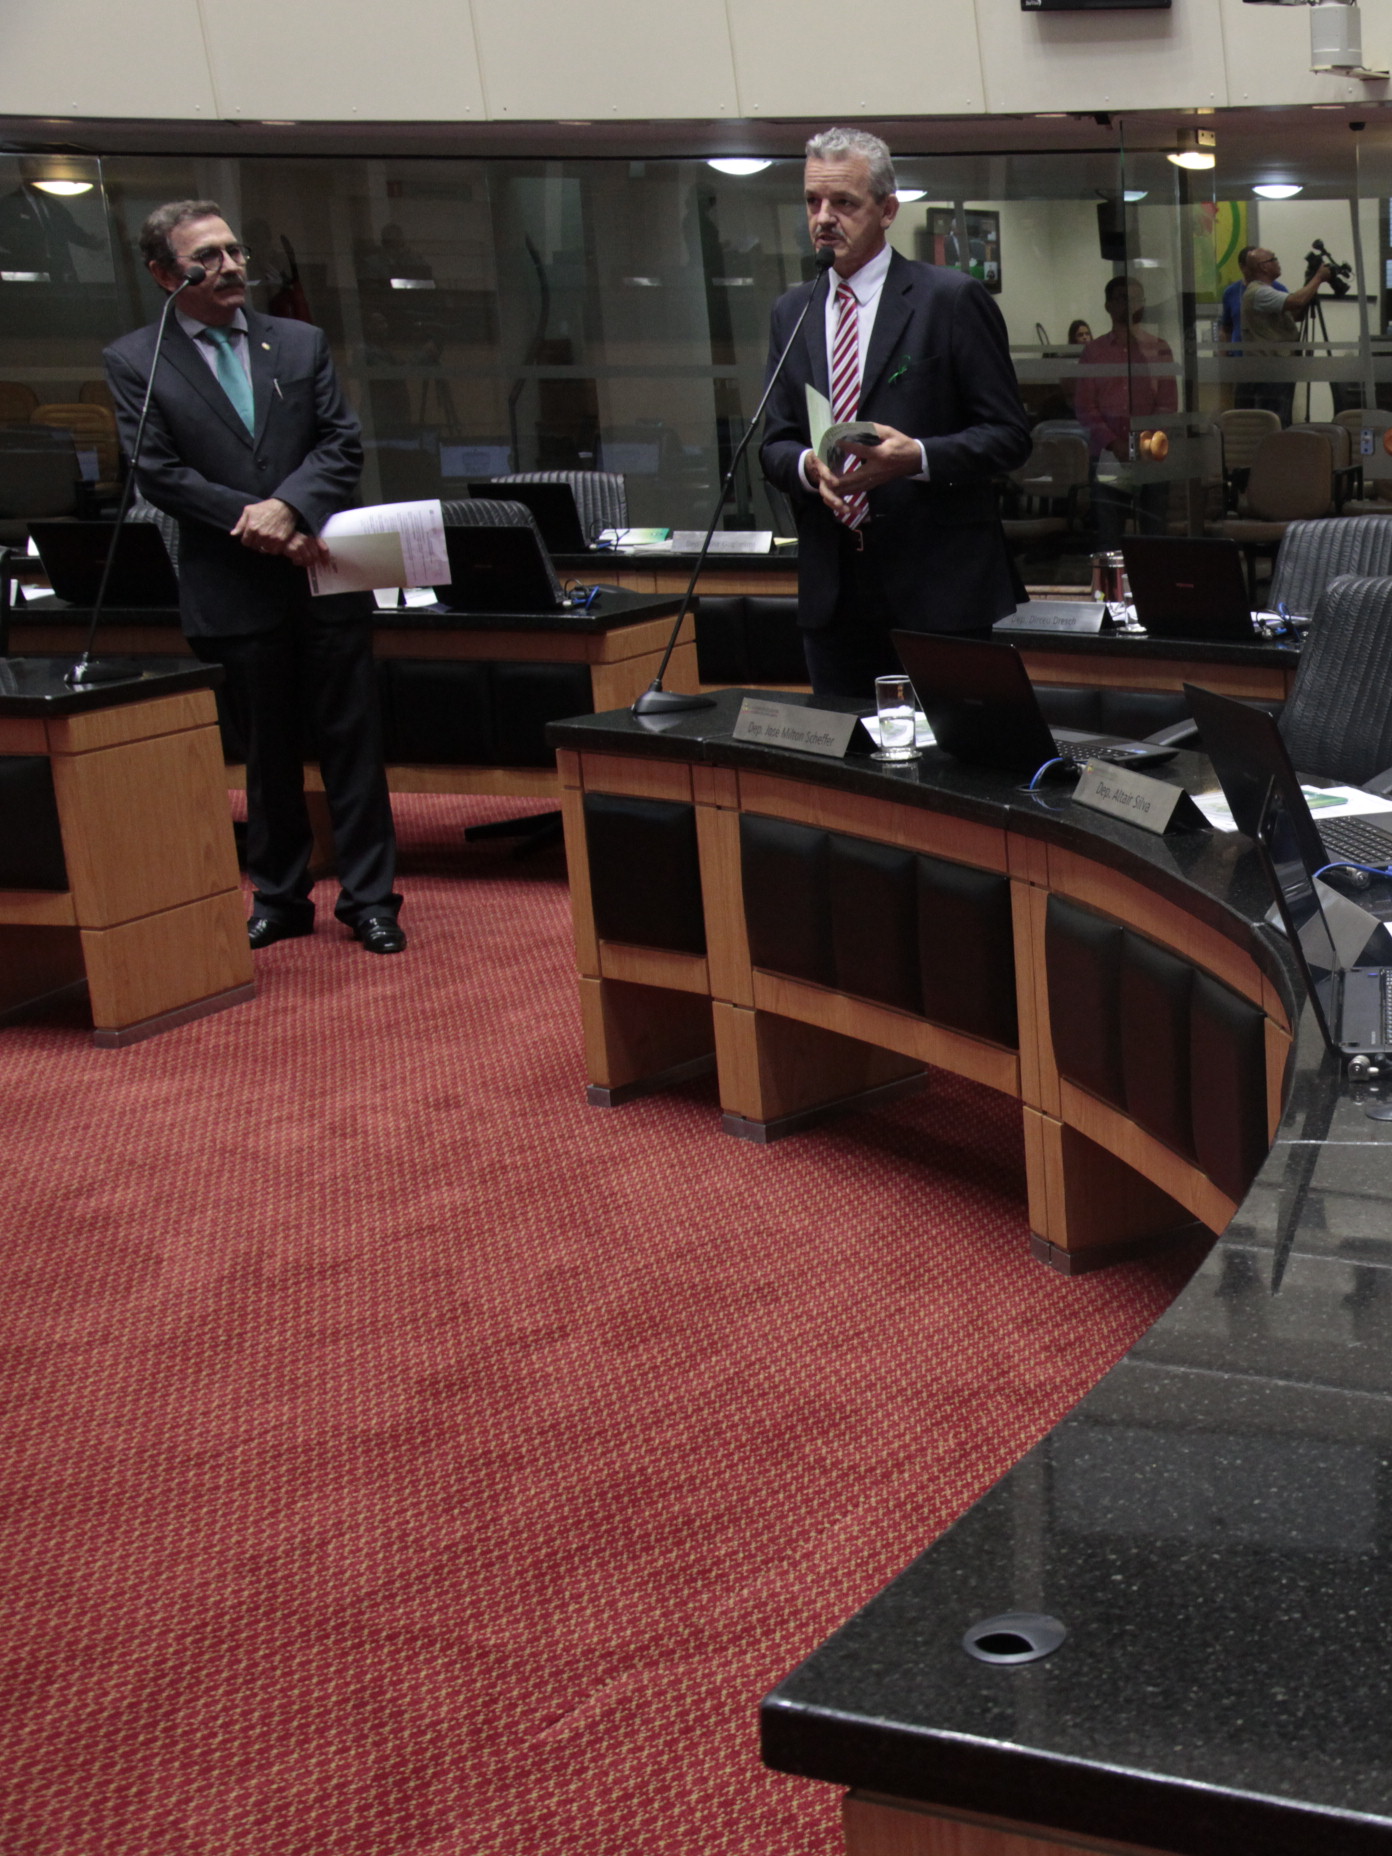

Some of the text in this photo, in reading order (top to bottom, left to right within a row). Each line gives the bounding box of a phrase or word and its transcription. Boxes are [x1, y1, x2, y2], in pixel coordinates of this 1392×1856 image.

[1012, 615, 1077, 626] Dep. Dirceu Dresch
[748, 721, 762, 737] Dep.
[781, 726, 805, 742] Milton
[805, 731, 835, 746] Scheffer
[1096, 782, 1151, 814] Dep. Altair Silva
